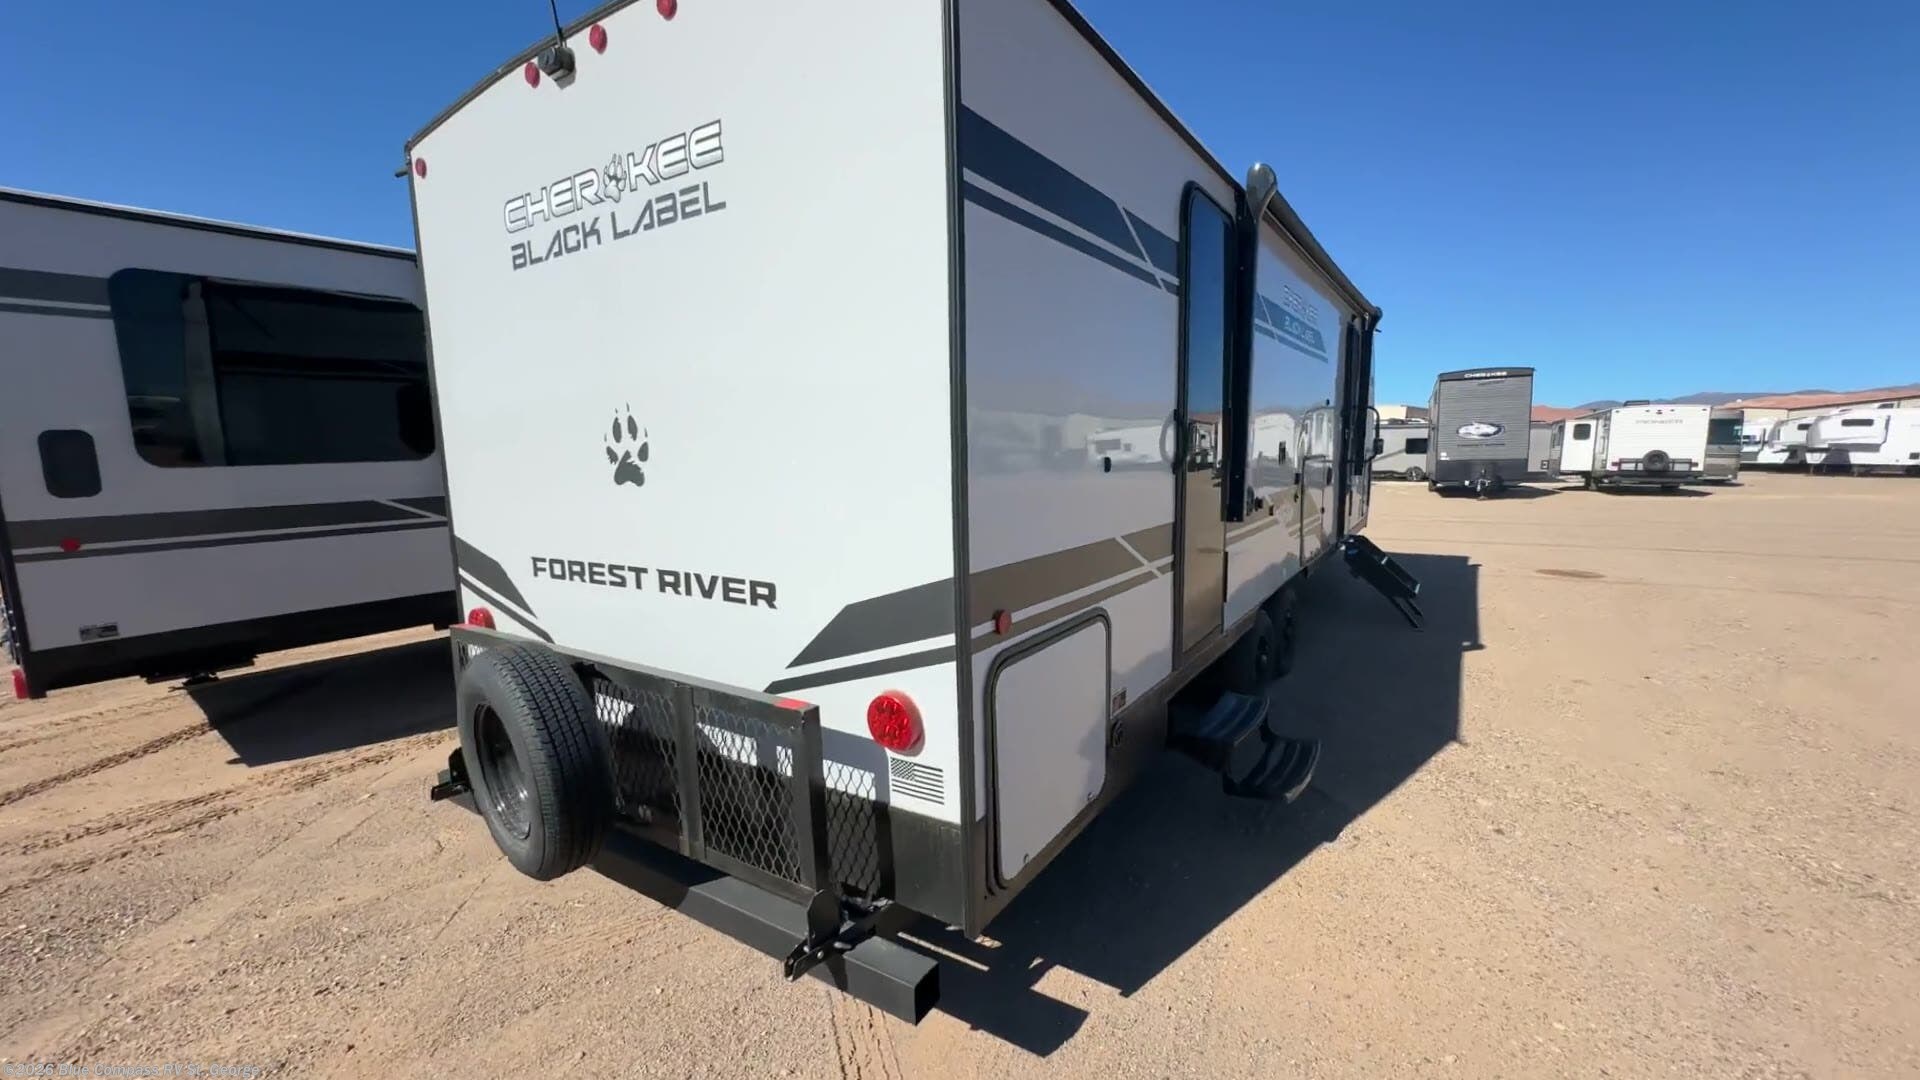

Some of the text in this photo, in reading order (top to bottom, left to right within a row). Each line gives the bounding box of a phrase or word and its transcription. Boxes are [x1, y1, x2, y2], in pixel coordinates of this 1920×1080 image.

[510, 181, 726, 270] BLACK LABEL
[531, 556, 777, 609] FOREST RIVER
